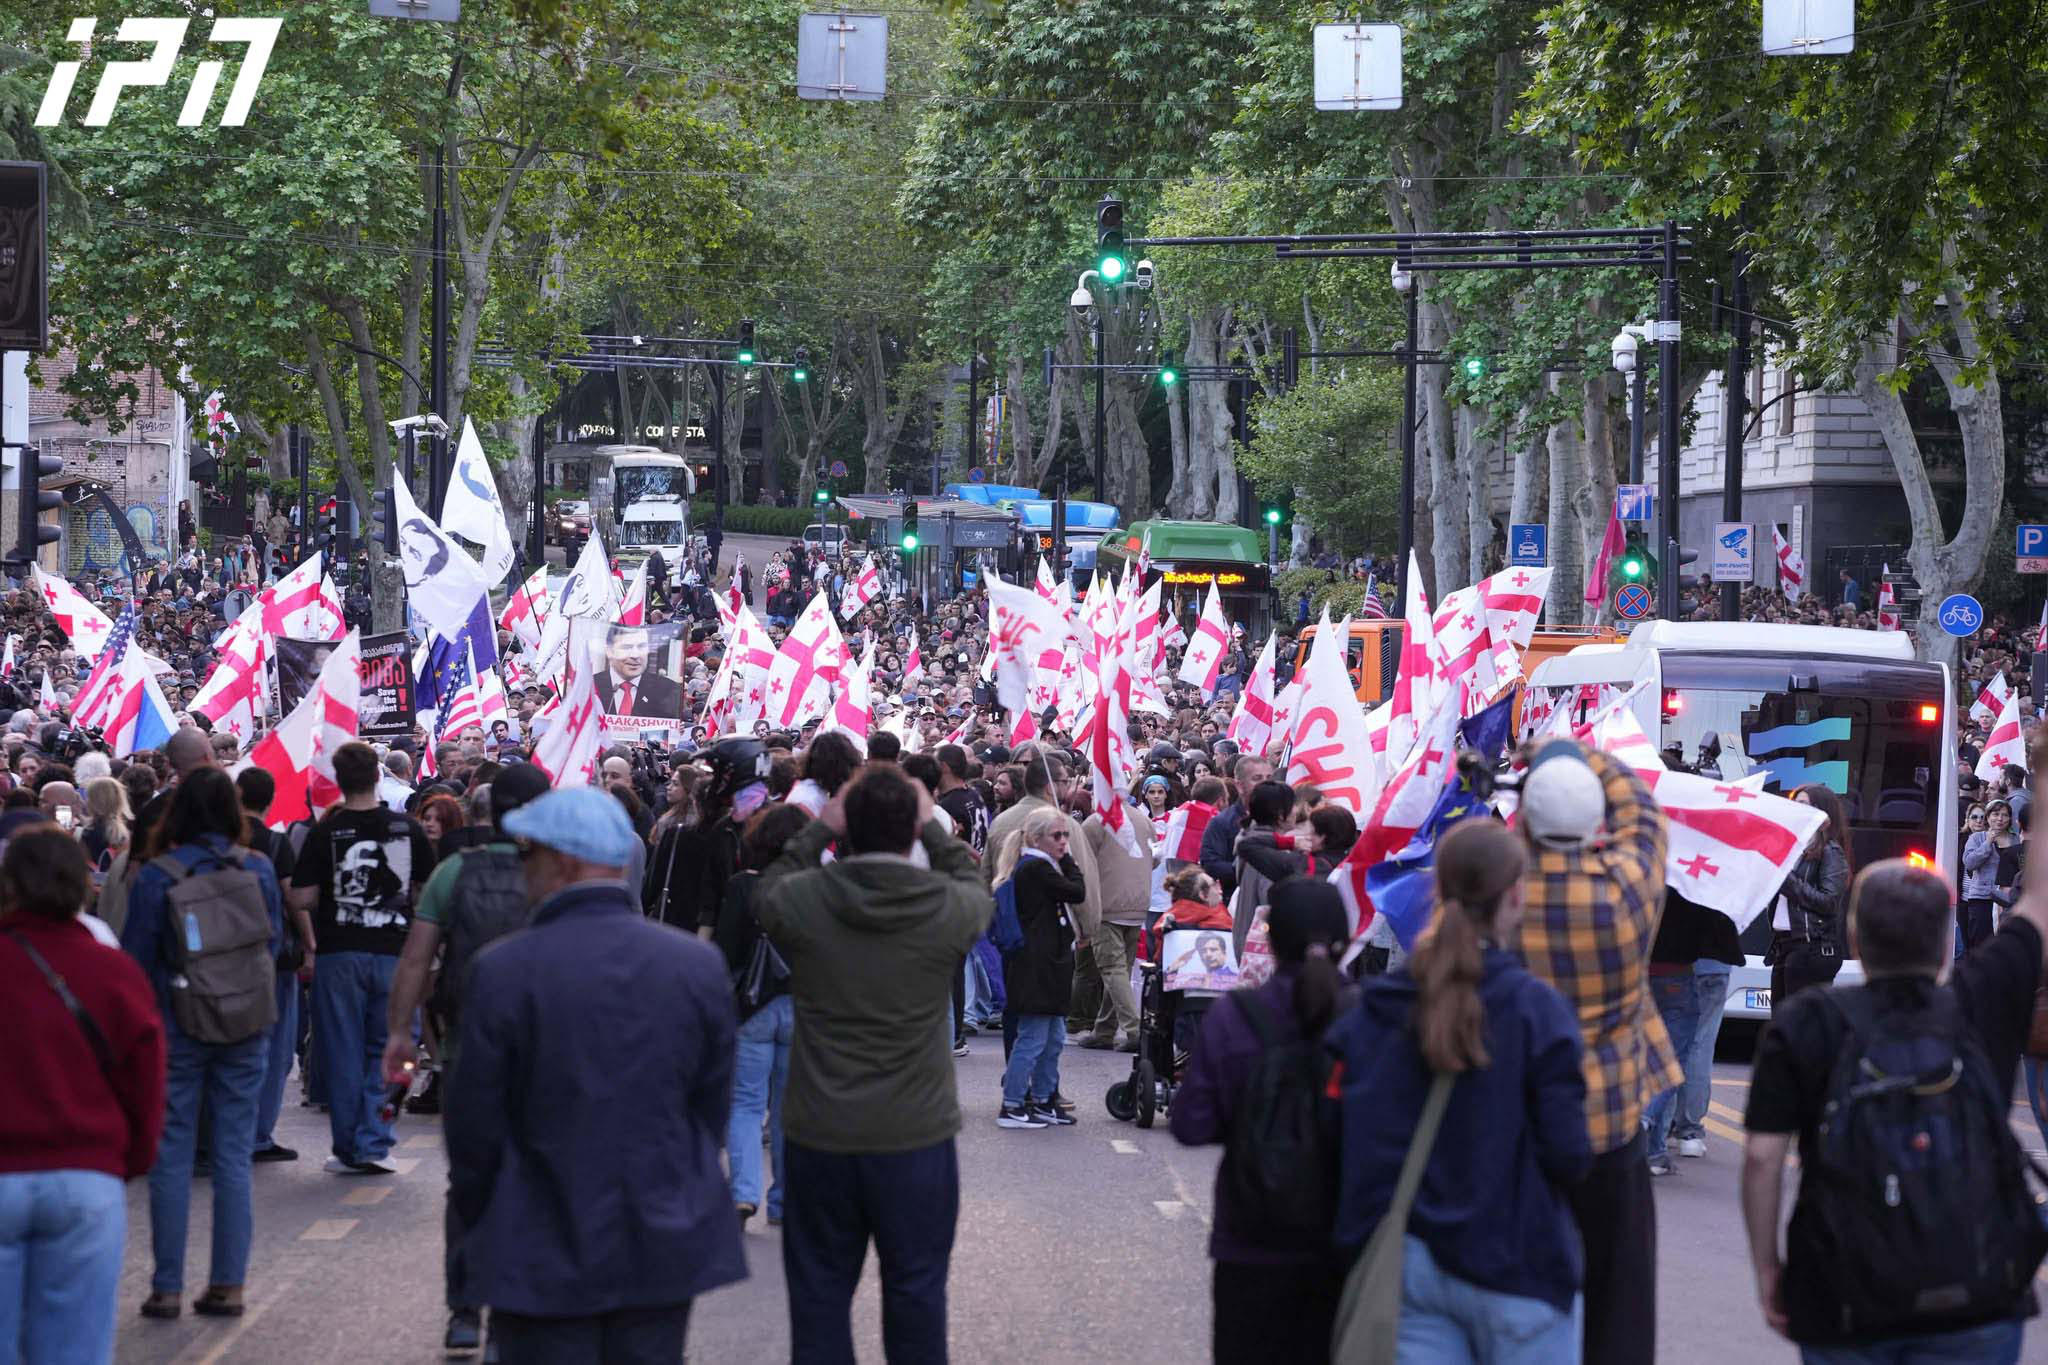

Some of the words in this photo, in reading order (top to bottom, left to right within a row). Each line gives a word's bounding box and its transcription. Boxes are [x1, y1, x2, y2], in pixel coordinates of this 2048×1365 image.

[1040, 537, 1052, 548] 38
[2024, 528, 2043, 554] P
[377, 688, 396, 697] Save
[383, 696, 397, 705] the
[604, 715, 680, 730] AAKASHVILI
